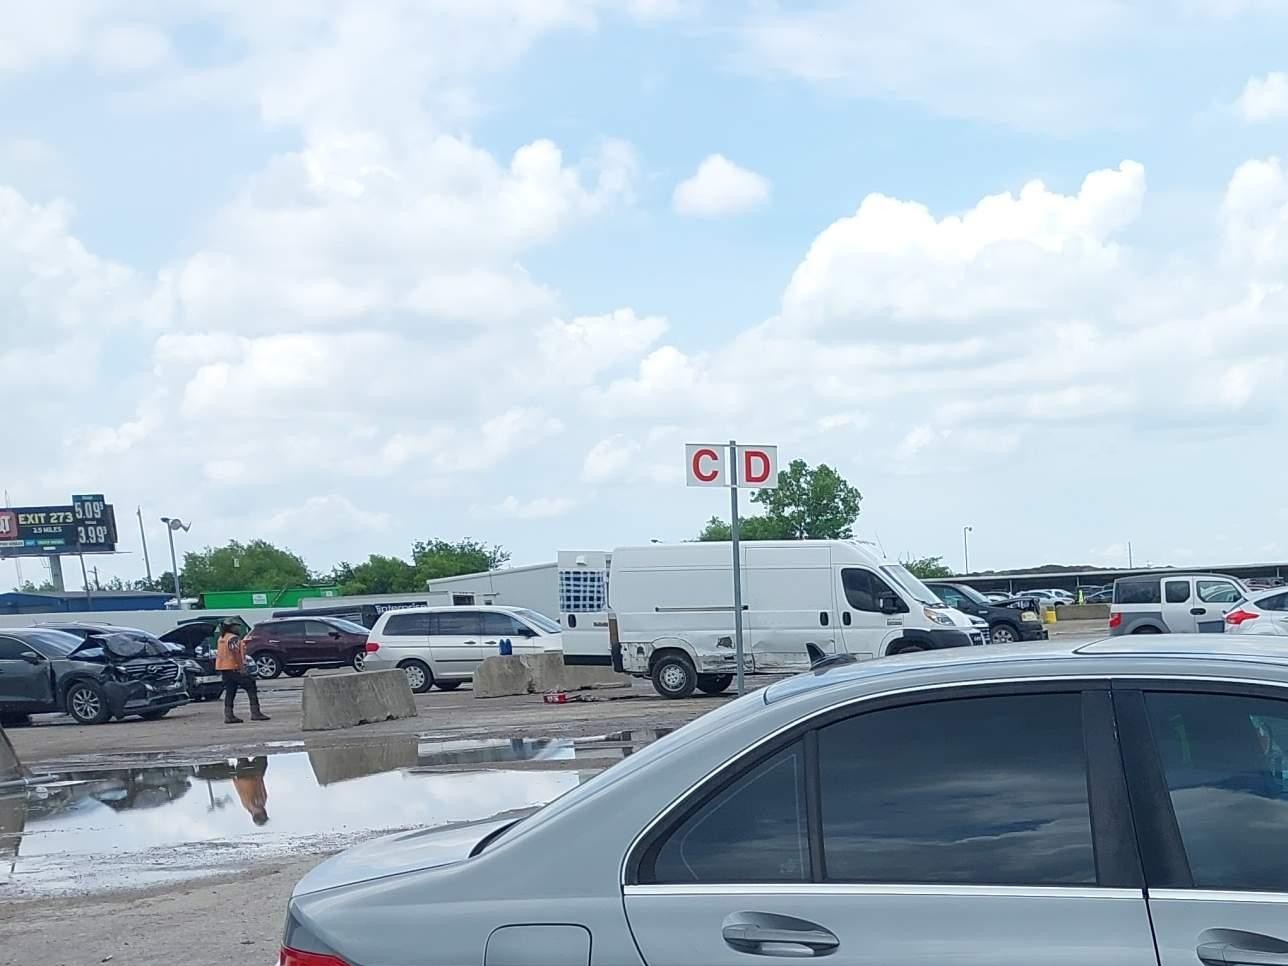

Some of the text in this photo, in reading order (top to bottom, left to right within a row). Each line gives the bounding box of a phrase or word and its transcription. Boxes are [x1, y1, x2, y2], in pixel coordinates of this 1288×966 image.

[692, 449, 720, 482] C
[744, 451, 771, 483] D
[18, 511, 74, 525] EXIT 273
